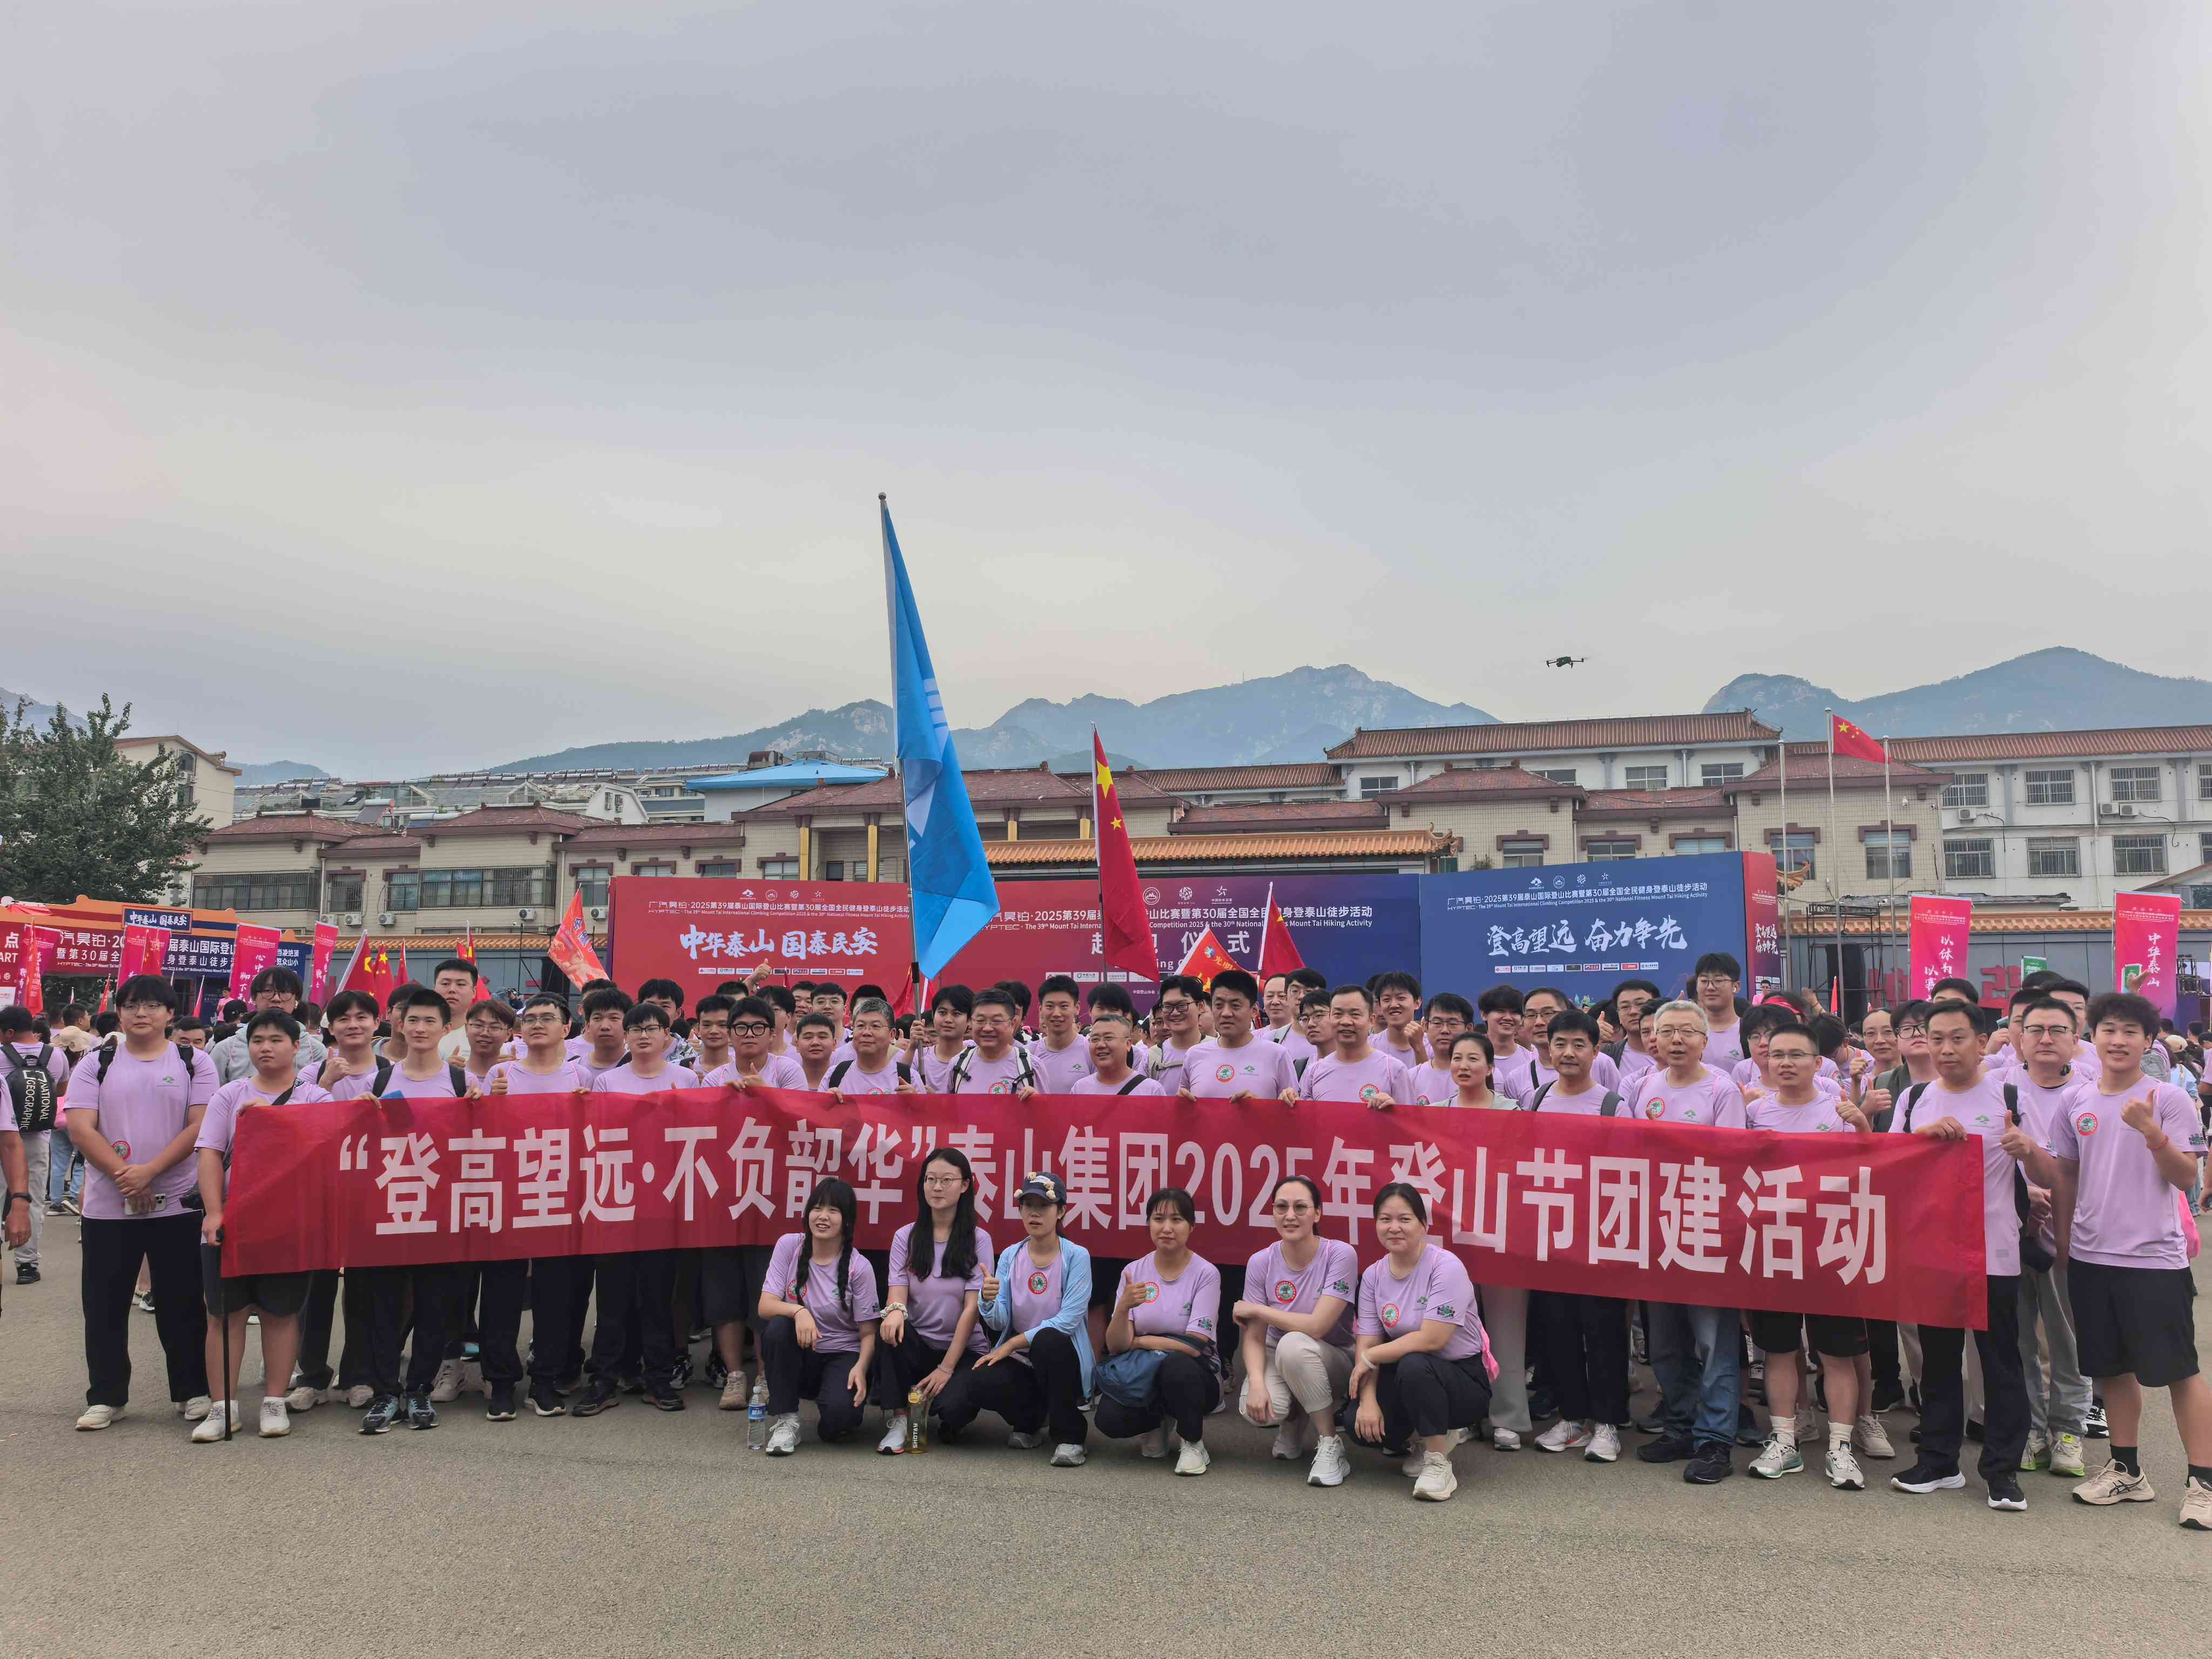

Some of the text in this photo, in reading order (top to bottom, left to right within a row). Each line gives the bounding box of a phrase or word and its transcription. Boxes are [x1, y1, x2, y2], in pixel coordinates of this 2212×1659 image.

[5, 932, 19, 949] 点
[679, 924, 878, 960] 中华泰山 国泰民安
[1324, 920, 1345, 928] Hiking
[1346, 919, 1372, 927] Activity
[1487, 915, 1688, 956] 登高望远 奋力争先
[167, 955, 234, 967] 身登泰山徒步
[1939, 934, 1953, 979] 以体为
[2147, 933, 2162, 987] 中华泰山
[19, 1080, 35, 1130] GEOGRAPHIC
[39, 1082, 51, 1122] NATIONAL
